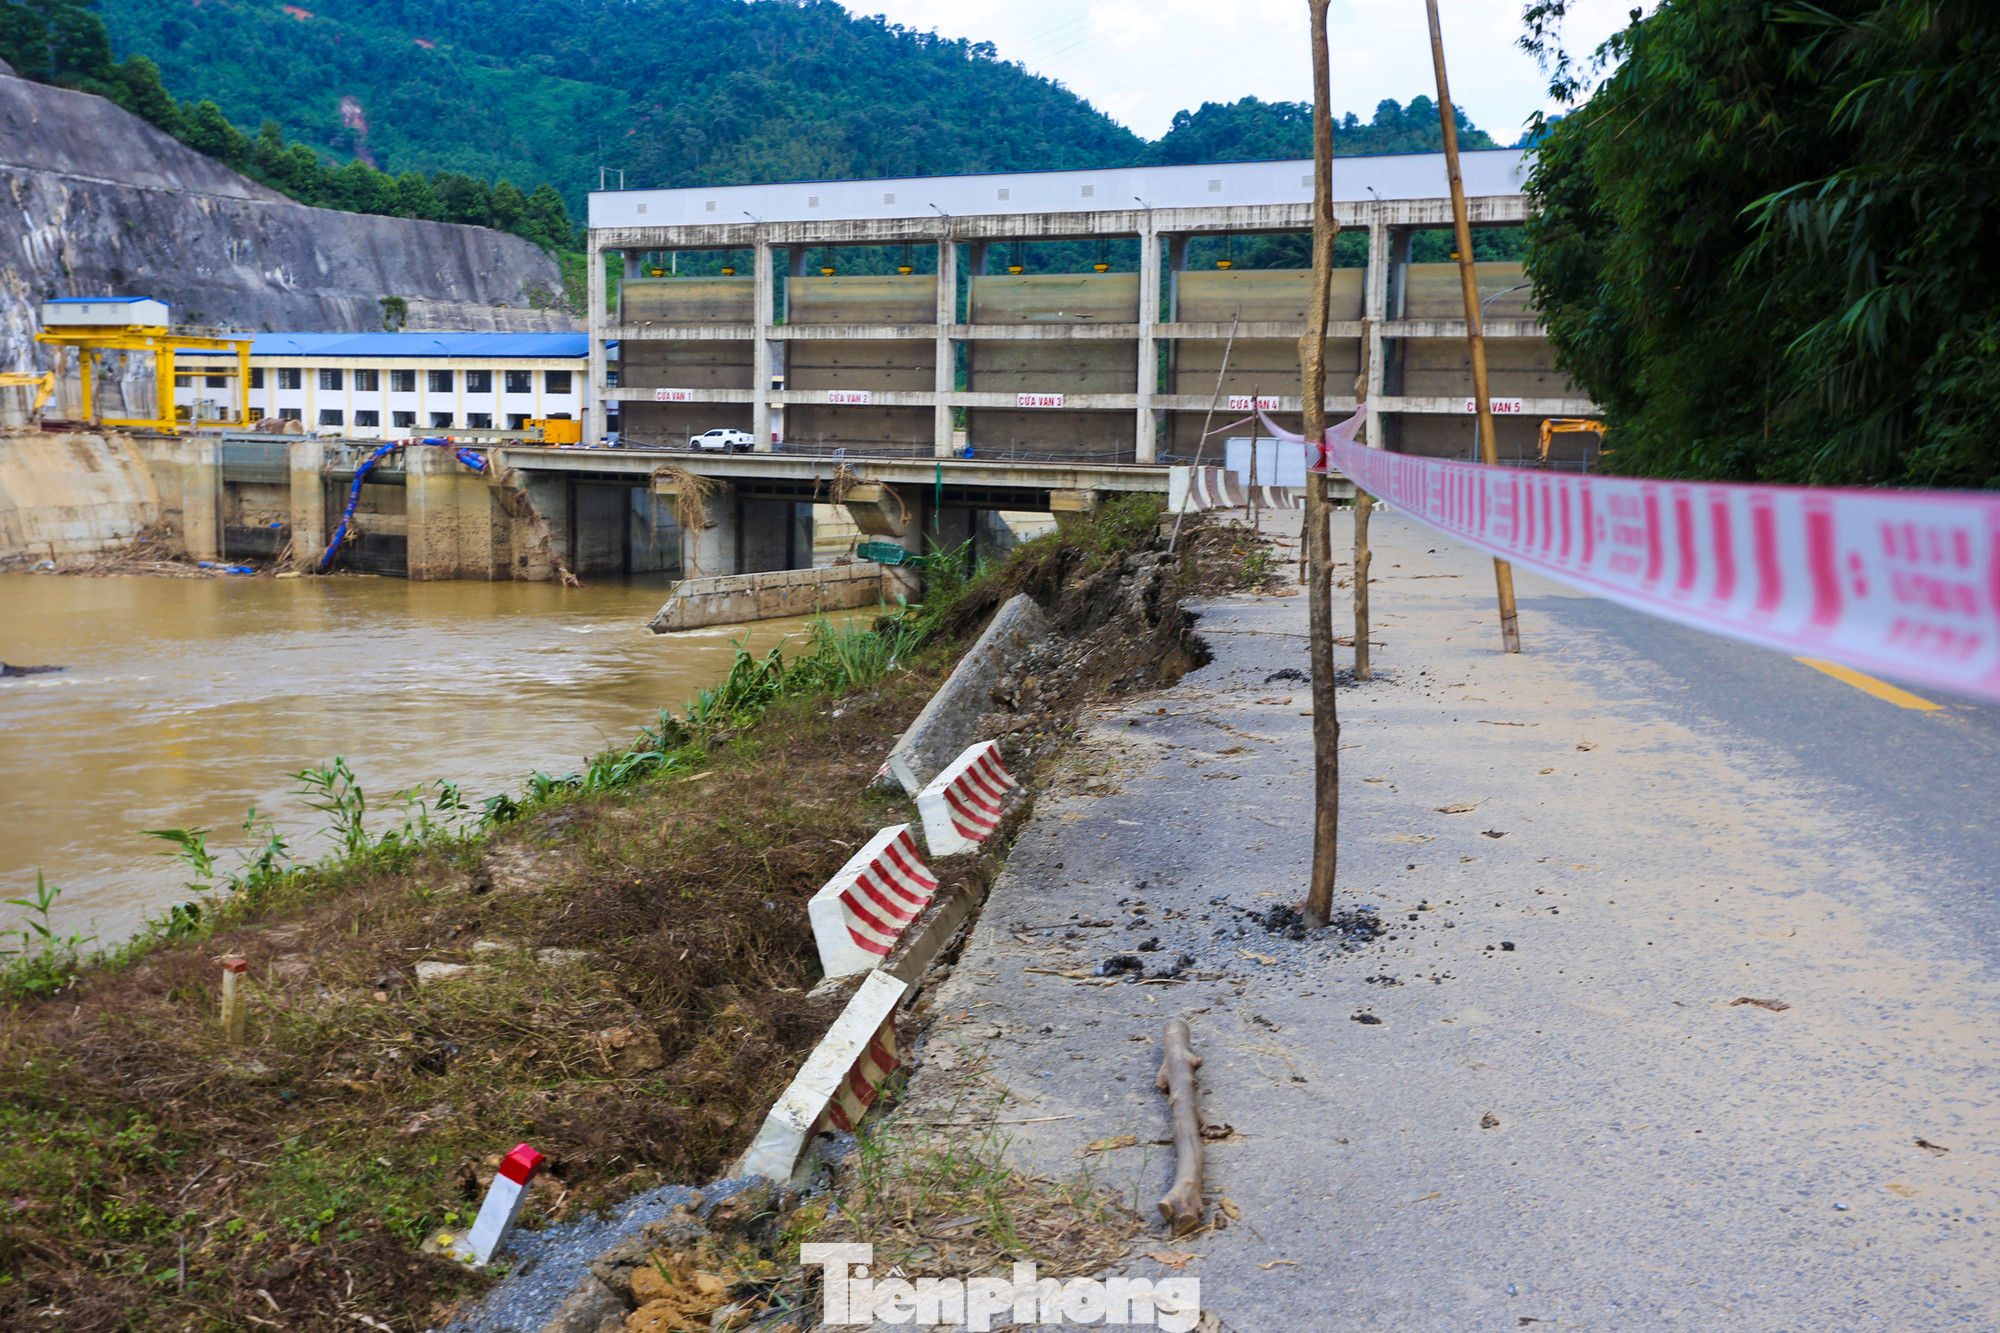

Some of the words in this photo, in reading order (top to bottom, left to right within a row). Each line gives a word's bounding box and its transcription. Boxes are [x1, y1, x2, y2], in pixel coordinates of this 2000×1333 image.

[847, 393, 861, 403] VAN
[863, 394, 868, 403] 2
[1039, 396, 1054, 406] VAN
[1057, 397, 1062, 407] 3
[1272, 400, 1278, 410] 4
[1491, 402, 1511, 412] VAN
[1514, 402, 1521, 412] 5
